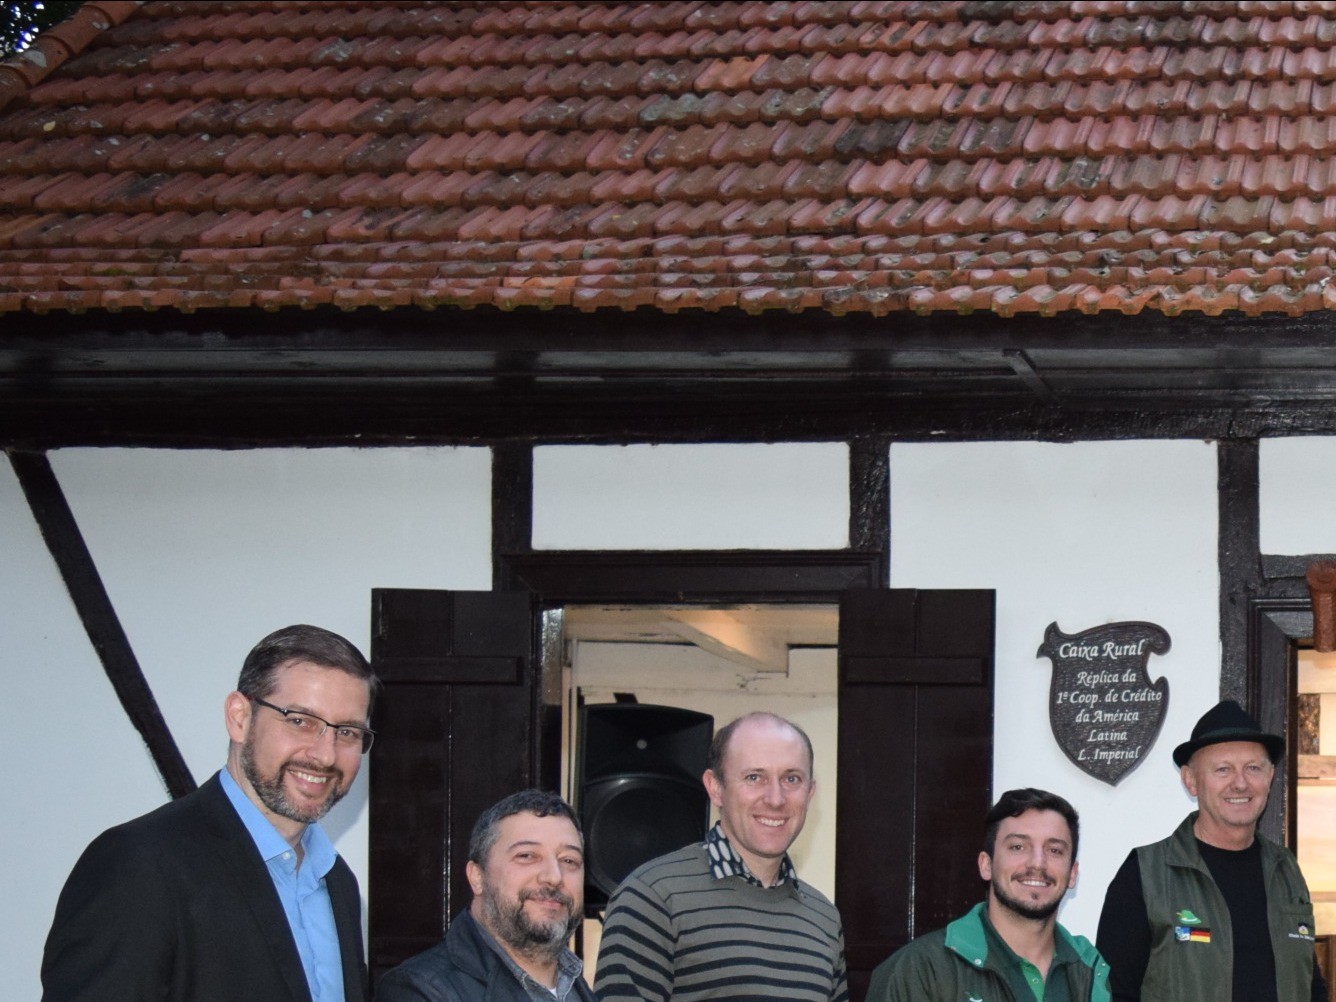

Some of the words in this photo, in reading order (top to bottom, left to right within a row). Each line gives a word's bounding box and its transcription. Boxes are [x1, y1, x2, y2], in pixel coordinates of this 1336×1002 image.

[1059, 641, 1098, 661] Caixa
[1102, 639, 1145, 659] Rural
[1077, 670, 1119, 688] Réplica
[1122, 669, 1137, 683] da
[1070, 691, 1102, 708] Coop.
[1105, 689, 1119, 703] de
[1121, 689, 1163, 702] Crédito
[1075, 709, 1090, 723] da
[1092, 709, 1140, 723] América
[1087, 729, 1128, 742] Latina
[1077, 749, 1091, 761] L.
[1094, 746, 1140, 764] Imperial
